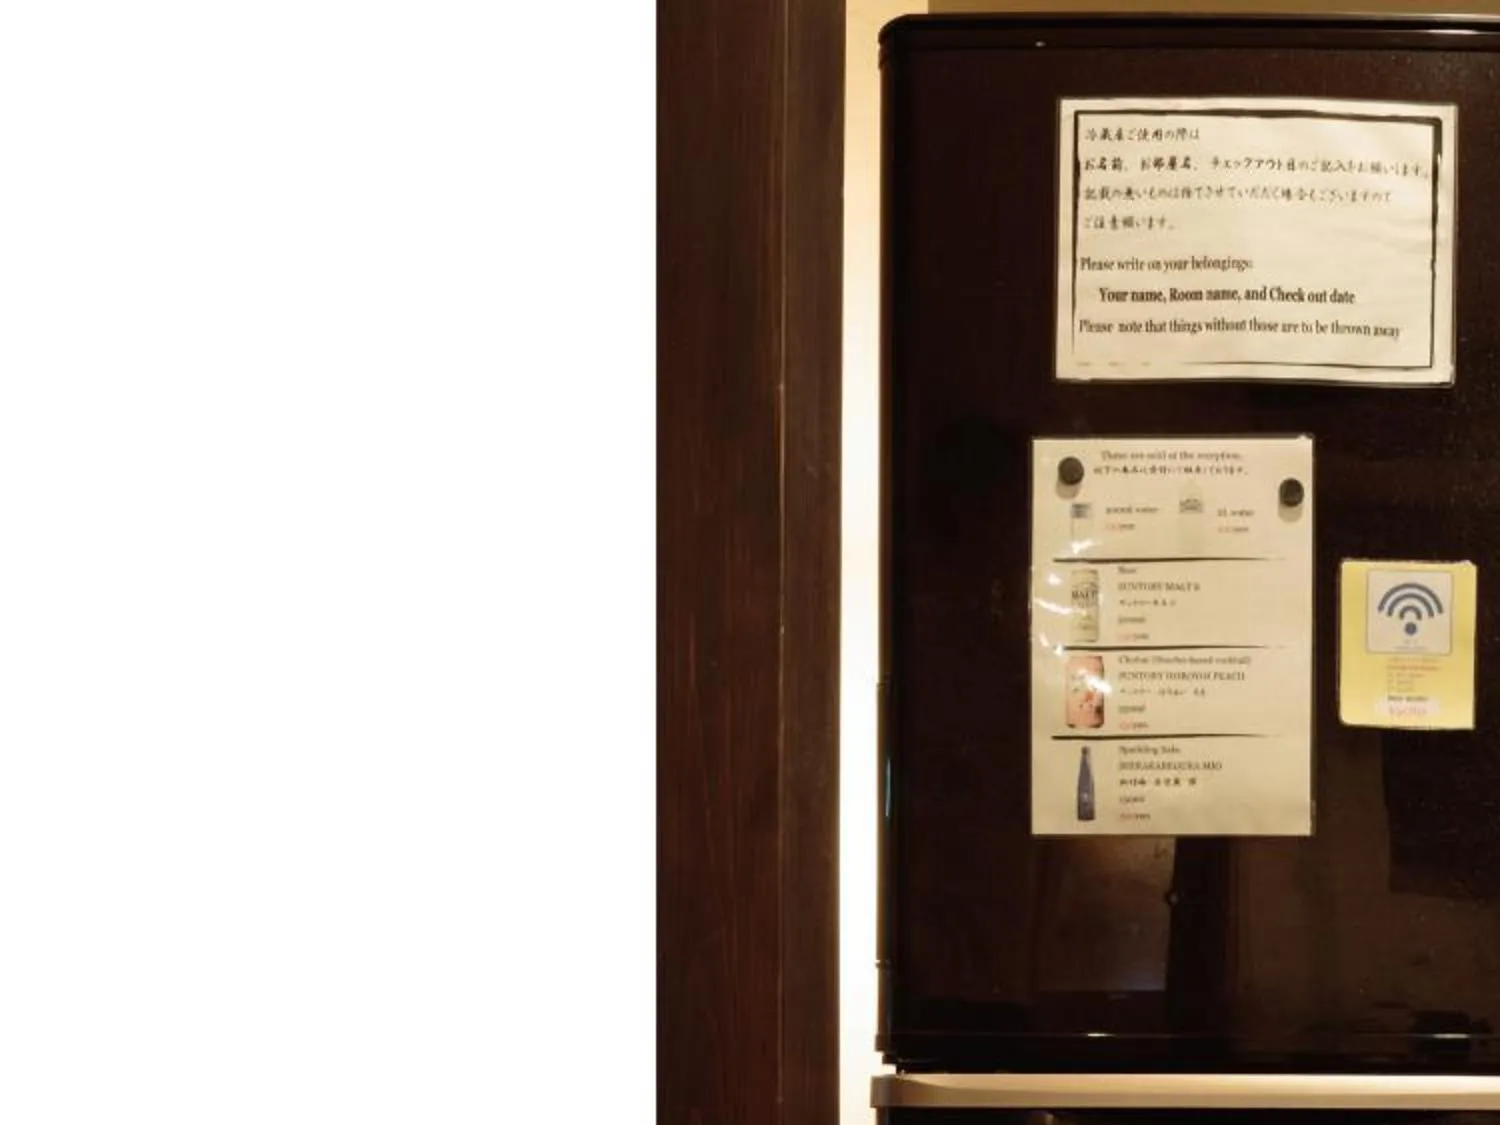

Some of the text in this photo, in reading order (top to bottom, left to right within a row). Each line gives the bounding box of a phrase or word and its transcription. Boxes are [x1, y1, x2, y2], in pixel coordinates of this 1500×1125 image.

[1080, 256, 1114, 271] Please
[1117, 256, 1145, 271] write
[1148, 260, 1161, 270] on
[1163, 259, 1189, 274] your
[1099, 285, 1356, 304] Your name, Room name, and Check out date
[1079, 319, 1113, 334] Please
[1119, 319, 1143, 334] note
[1145, 319, 1167, 333] that
[1169, 318, 1203, 336] things
[1205, 317, 1247, 333] without
[1249, 316, 1279, 333] those
[1281, 321, 1299, 334] are
[1301, 319, 1313, 334] to
[1316, 319, 1329, 335] be
[1331, 319, 1371, 337] thrown
